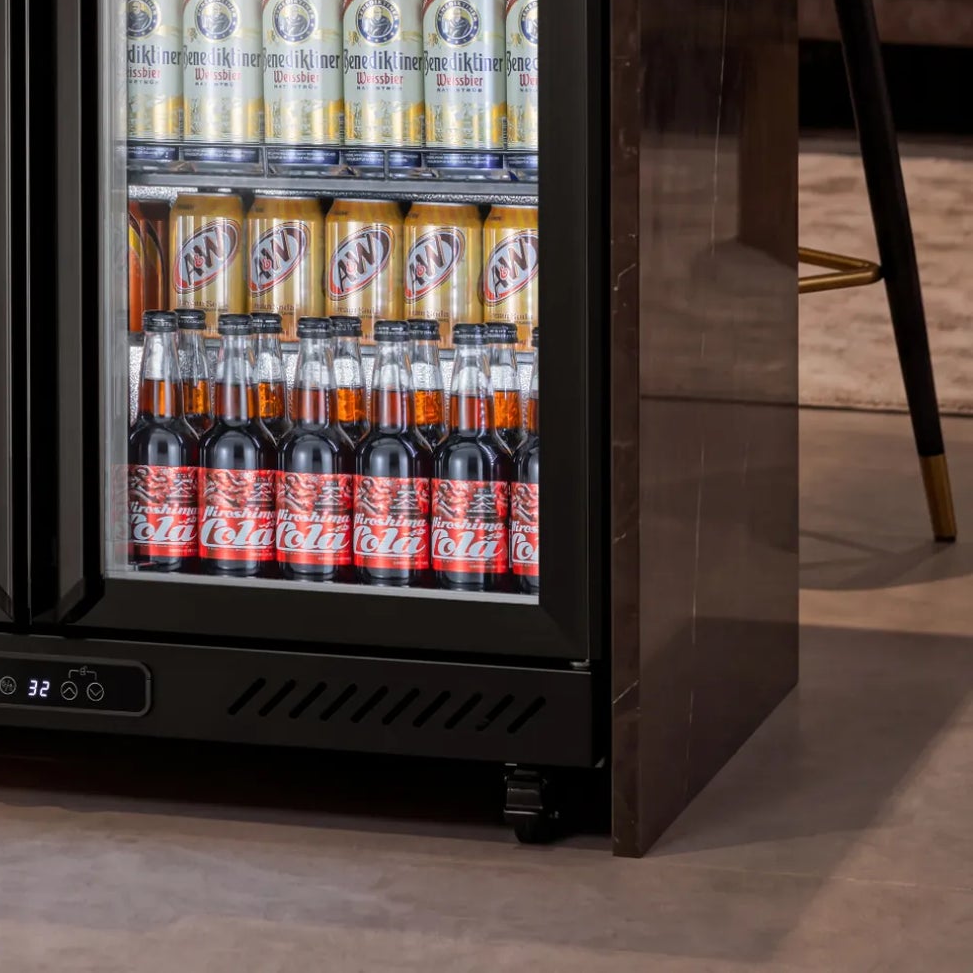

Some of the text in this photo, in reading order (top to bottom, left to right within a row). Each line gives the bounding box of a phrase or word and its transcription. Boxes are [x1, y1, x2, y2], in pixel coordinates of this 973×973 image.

[263, 47, 341, 74] Benediktiner
[344, 49, 422, 74] Benediktiner
[424, 50, 504, 75] Benediktiner
[195, 67, 241, 80] Weissbier
[273, 70, 319, 83] Weissbier
[357, 72, 403, 84] Weissbier
[436, 74, 483, 87] Weissbier
[183, 226, 225, 286] A&W
[254, 228, 291, 289] A&W
[338, 233, 376, 293] A&W
[409, 235, 446, 295] A&W
[493, 237, 528, 299] A&W
[203, 506, 275, 522] Hiroshima
[277, 509, 350, 524] Hiroshima
[354, 513, 427, 528] Hiroshima
[432, 517, 504, 532] Hiroshima
[201, 518, 276, 549] Cola
[276, 521, 350, 553] Cola
[353, 525, 426, 558] Cola
[432, 529, 503, 560] Cola
[28, 679, 50, 697] 32
